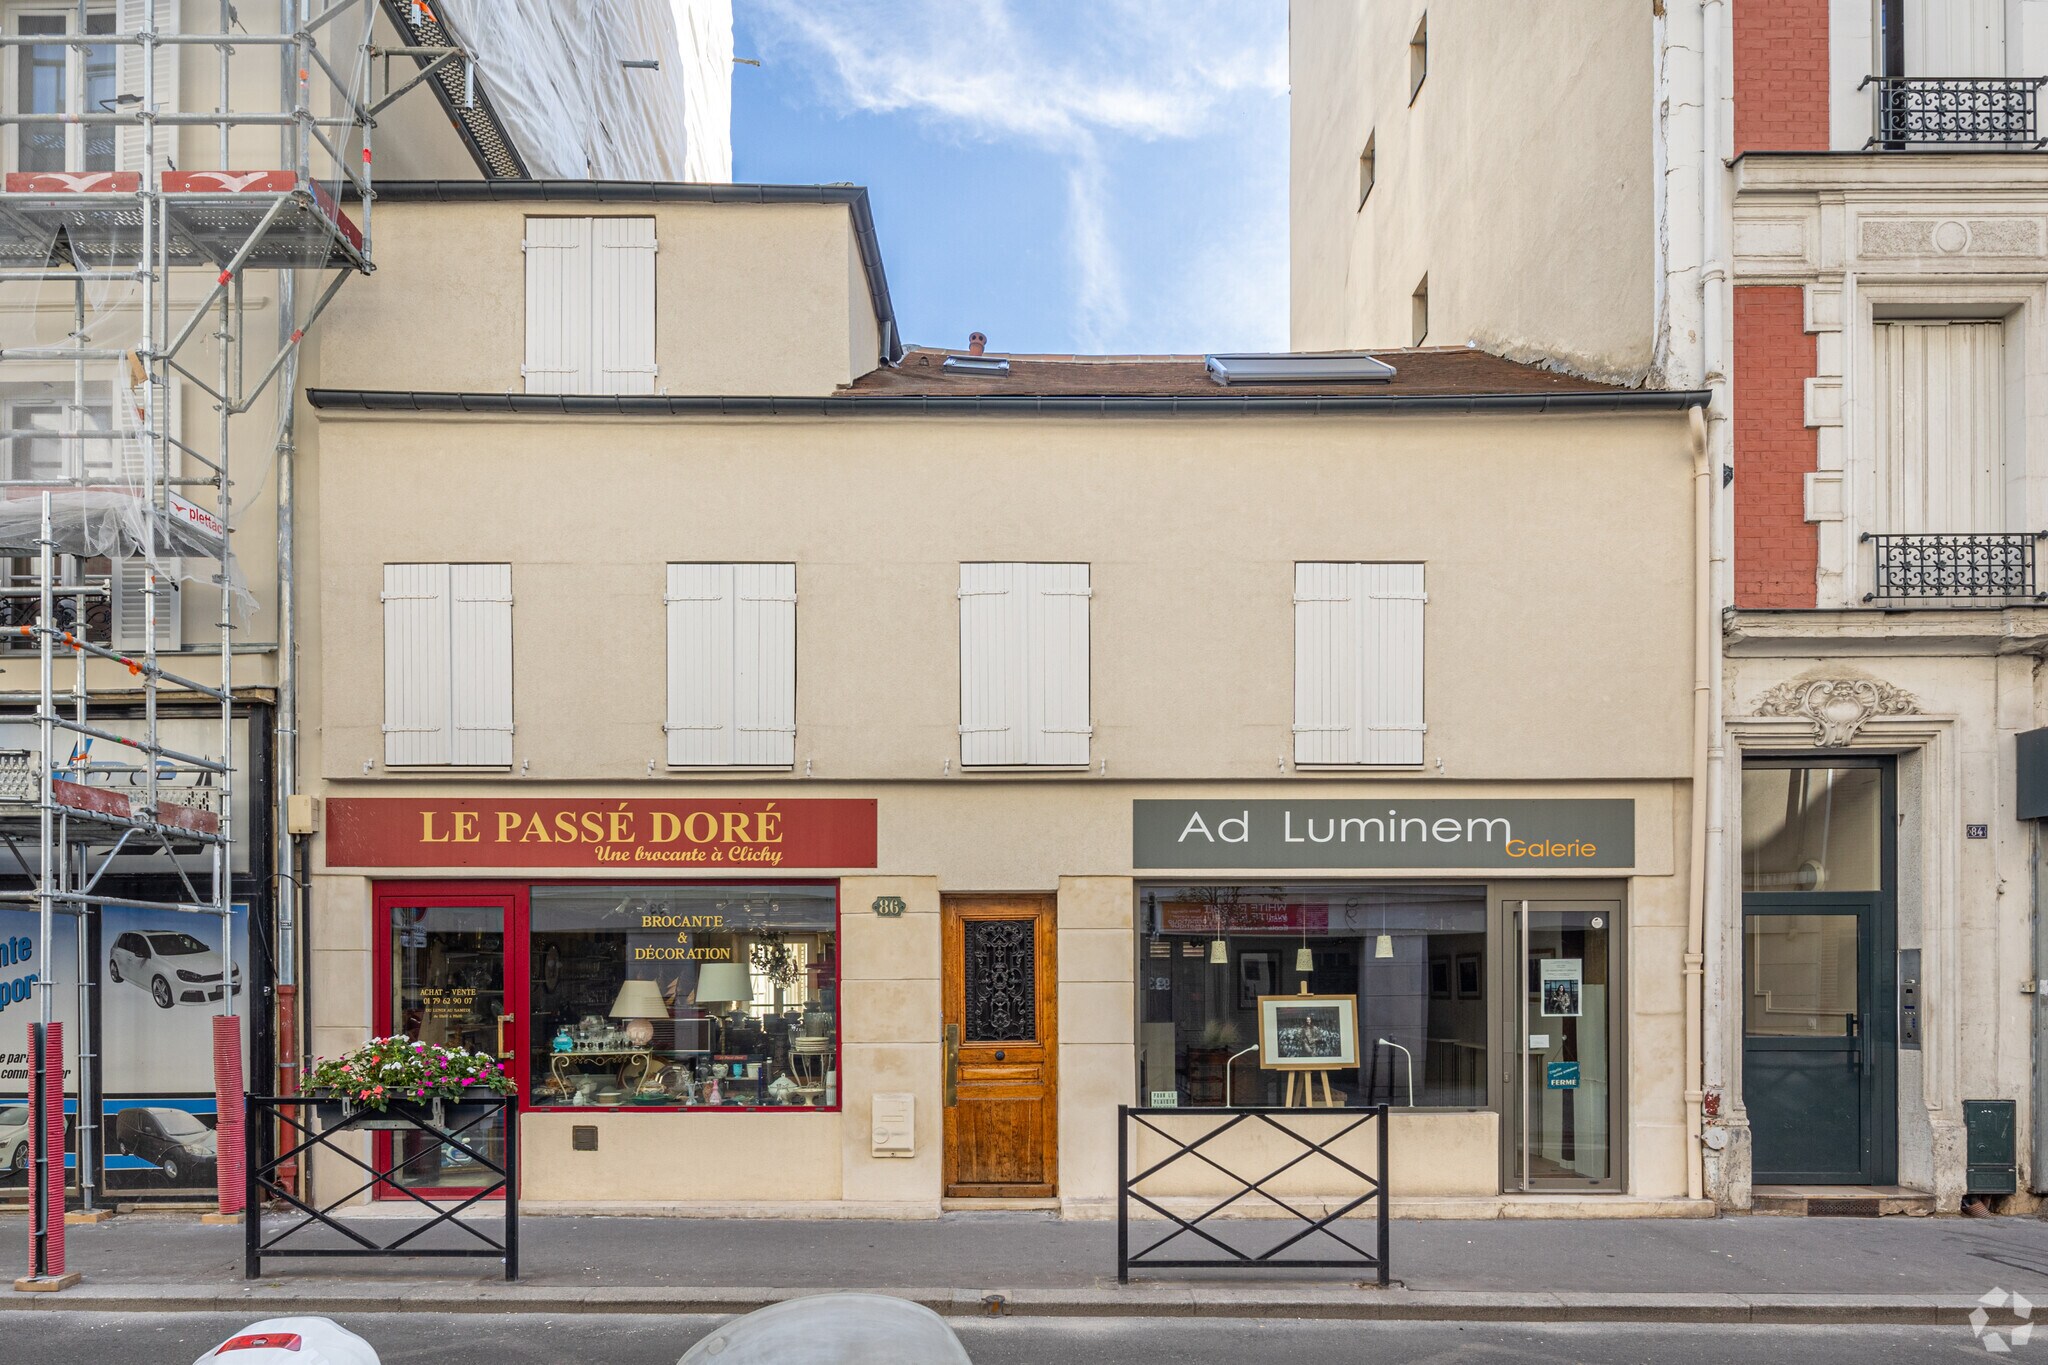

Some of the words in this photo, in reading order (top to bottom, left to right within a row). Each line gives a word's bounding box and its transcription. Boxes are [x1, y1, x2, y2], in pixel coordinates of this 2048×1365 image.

[189, 507, 223, 535] plettac
[419, 811, 481, 843] LE
[494, 802, 636, 843] PASSÉ
[648, 802, 784, 843] DORÉ
[1177, 810, 1249, 843] Ad
[1284, 809, 1511, 844] Luminem
[1971, 826, 1984, 837] 84
[595, 845, 631, 863] Une
[634, 845, 708, 863] brocante
[710, 846, 724, 863] à
[728, 845, 784, 867] Clichy
[1506, 839, 1597, 858] Galerie
[879, 899, 899, 914] 86
[641, 915, 724, 928] BROCANTE
[677, 931, 688, 944] &
[634, 944, 731, 960] DÉCORATION
[451, 988, 476, 996] VENTE
[423, 997, 430, 1005] 01
[433, 997, 440, 1005] 79
[453, 997, 462, 1005] 90
[464, 997, 473, 1005] 07
[1551, 1076, 1577, 1086] FERMÉ
